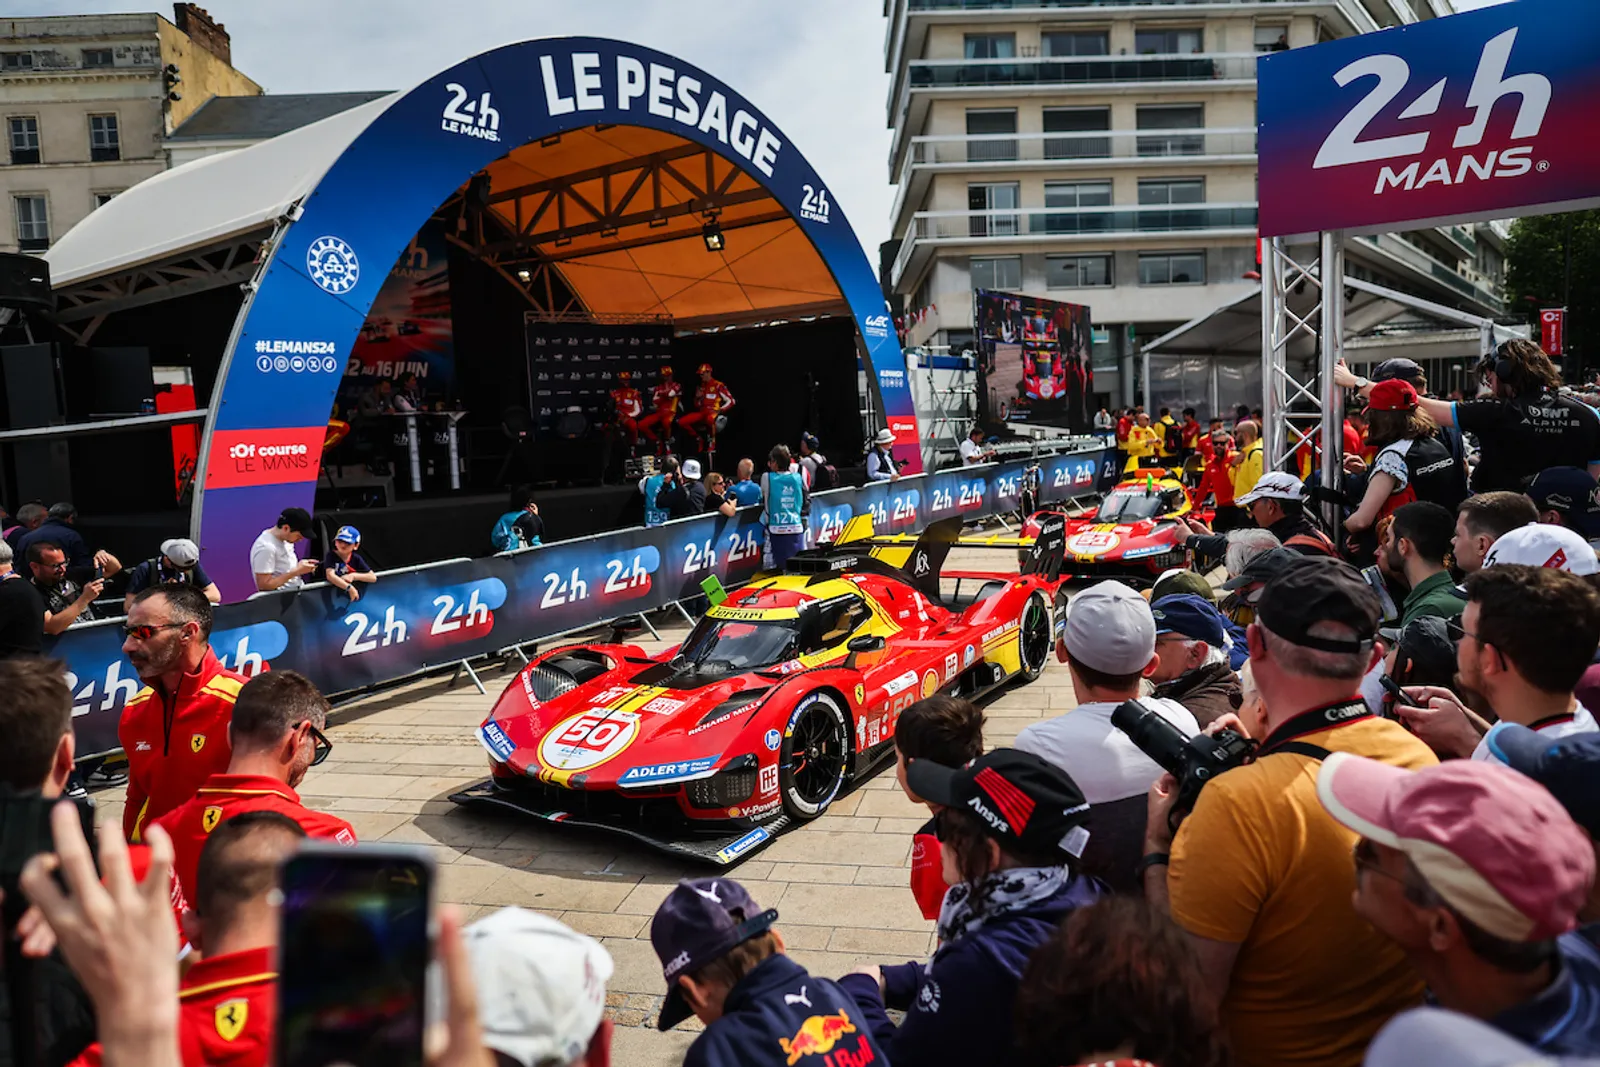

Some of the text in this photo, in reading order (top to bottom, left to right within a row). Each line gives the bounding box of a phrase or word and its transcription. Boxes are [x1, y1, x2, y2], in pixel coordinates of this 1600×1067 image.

[442, 83, 500, 130] 24h
[1313, 27, 1552, 169] 24h
[441, 119, 459, 133] LE
[539, 52, 782, 178] LE PESAGE
[801, 184, 830, 216] 24h
[865, 315, 889, 328] WEC
[255, 340, 336, 354] #LEMANS24
[376, 361, 392, 377] 16
[1520, 417, 1581, 427] ALPINE
[258, 444, 307, 456] course
[235, 455, 309, 473] LE MANS
[1075, 464, 1091, 483] 24h
[998, 478, 1016, 499] 24h
[1053, 468, 1071, 488] 24h
[893, 495, 915, 521] 24h
[932, 488, 952, 512] 24h
[959, 485, 982, 507] 24h
[683, 538, 716, 575] 24h
[728, 529, 758, 562] 24h
[604, 554, 648, 594] 24h
[538, 567, 588, 610] 24h
[431, 588, 489, 636] 24h
[341, 605, 407, 657] 24h
[64, 659, 138, 718] 24h
[688, 700, 763, 736] RICHARD MILLE
[1324, 703, 1368, 721] Canon
[561, 718, 620, 747] 50
[625, 764, 676, 779] ADLER
[967, 796, 1010, 834] Ansys
[832, 1034, 875, 1067] Bull
